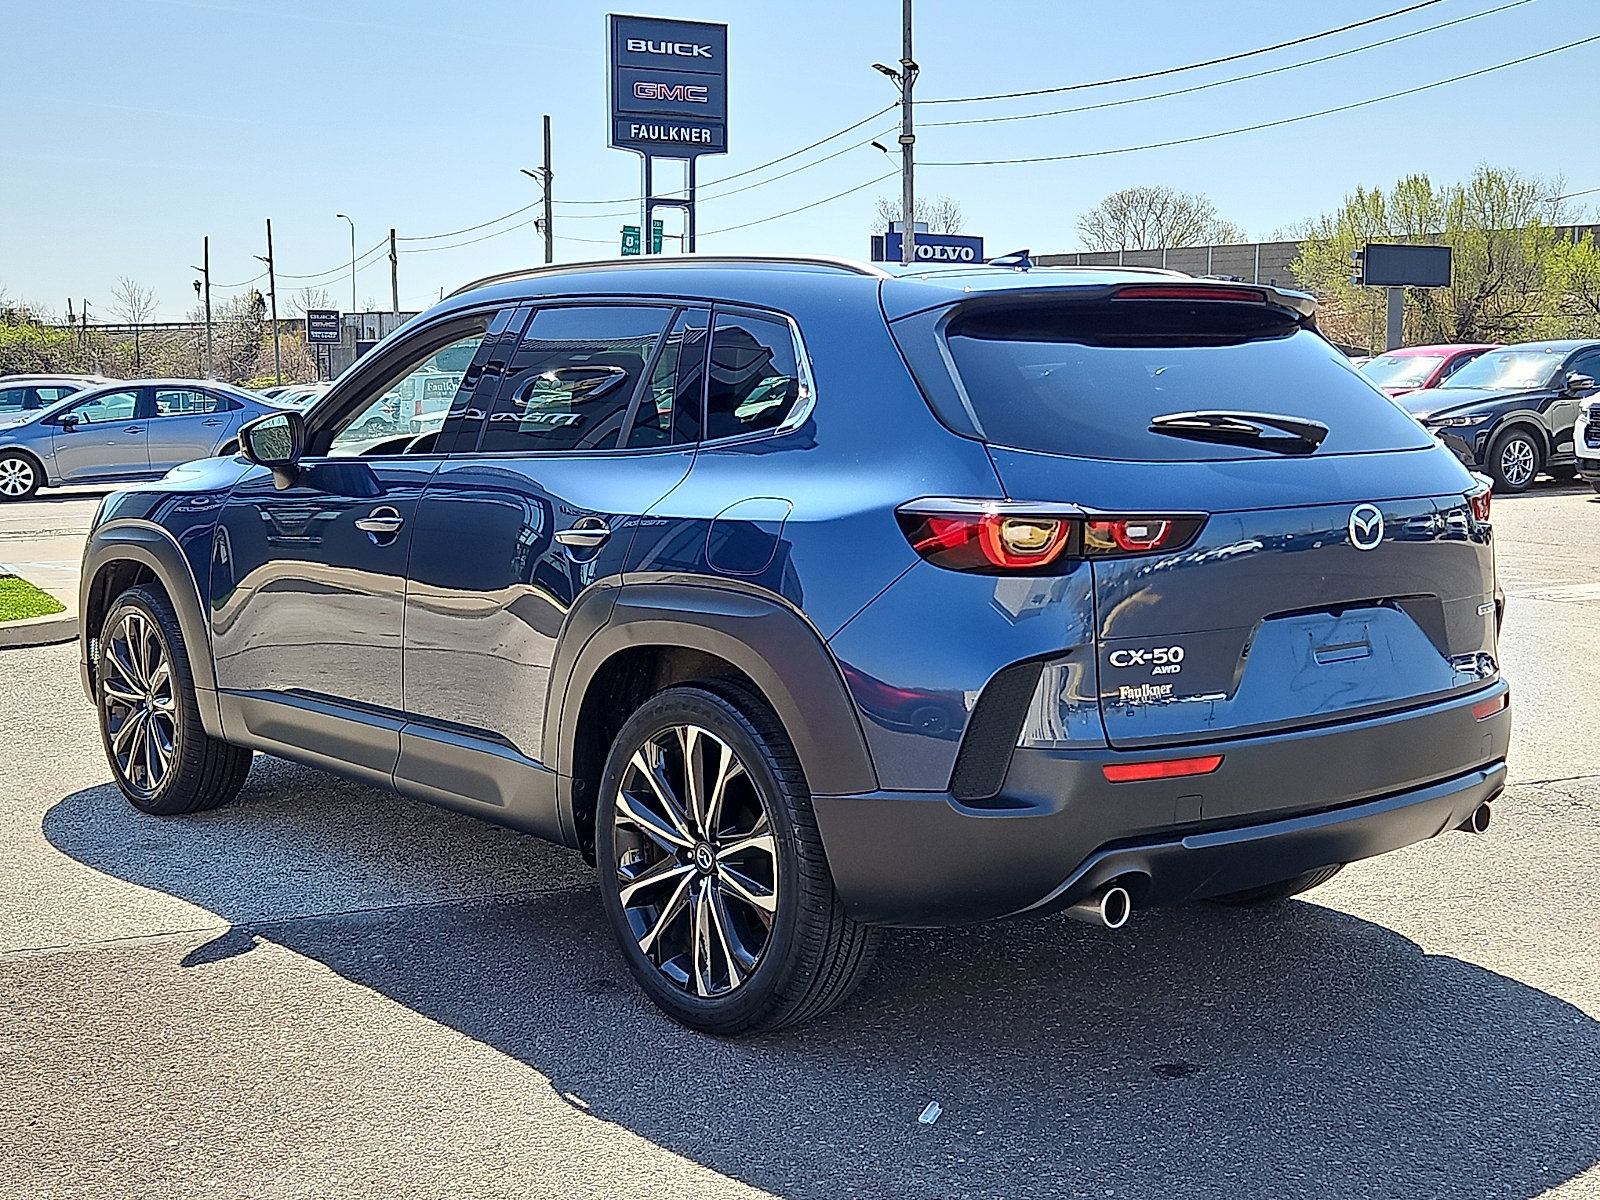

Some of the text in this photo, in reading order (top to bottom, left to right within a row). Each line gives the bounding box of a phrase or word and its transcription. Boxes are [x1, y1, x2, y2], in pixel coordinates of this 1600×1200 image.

[627, 39, 712, 58] BUICK
[633, 82, 708, 103] GMC
[630, 124, 711, 143] FAULKNER
[427, 381, 460, 392] Faulkn
[1109, 646, 1185, 667] CX-50
[1151, 664, 1181, 676] AWD
[1119, 683, 1173, 700] Faulkner
